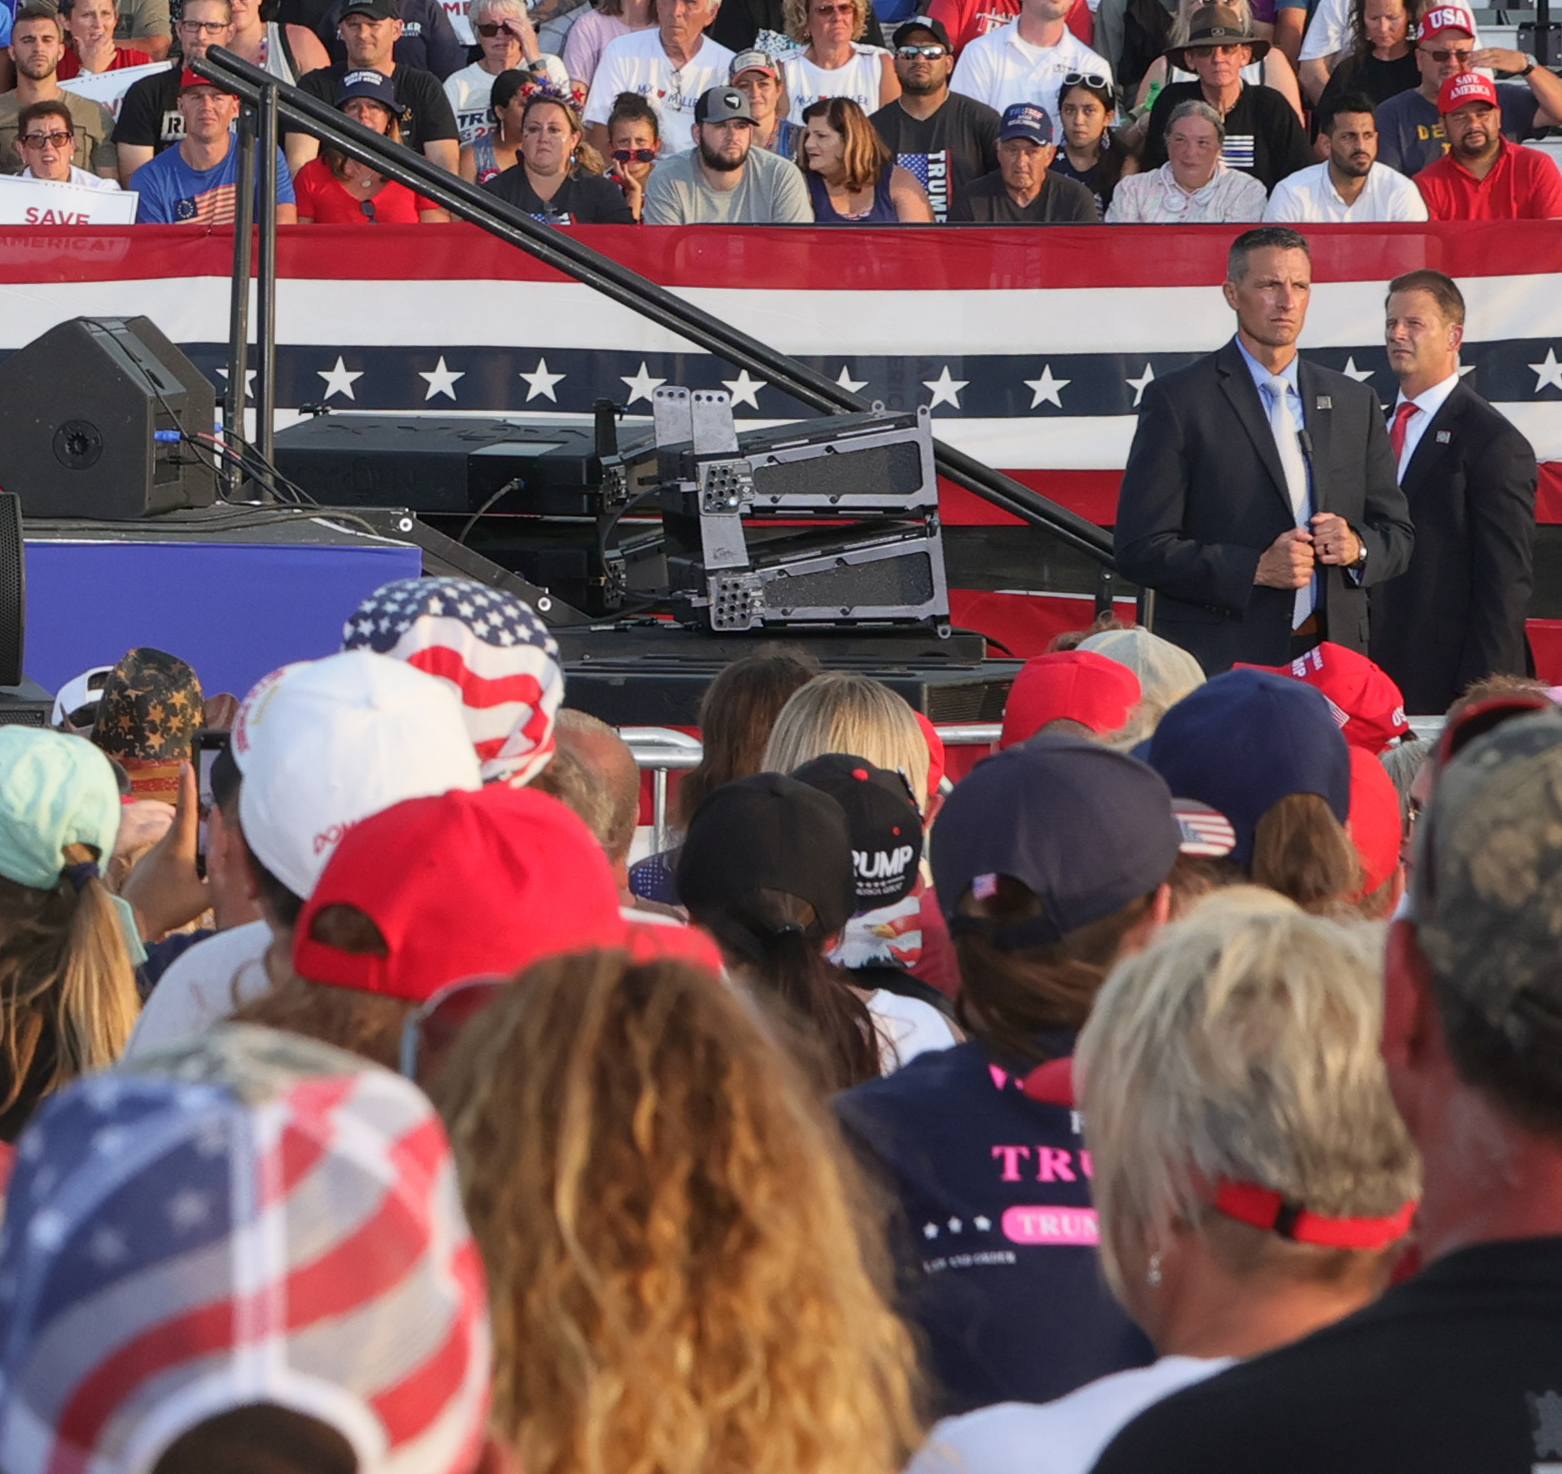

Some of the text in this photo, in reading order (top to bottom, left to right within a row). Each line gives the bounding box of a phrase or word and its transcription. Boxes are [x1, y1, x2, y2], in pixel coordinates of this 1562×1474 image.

[1429, 9, 1467, 28] USA
[1455, 75, 1480, 86] SAVE
[1450, 85, 1491, 97] AMERICA
[25, 207, 90, 224] SAVE
[1021, 1211, 1099, 1235] TRUM
